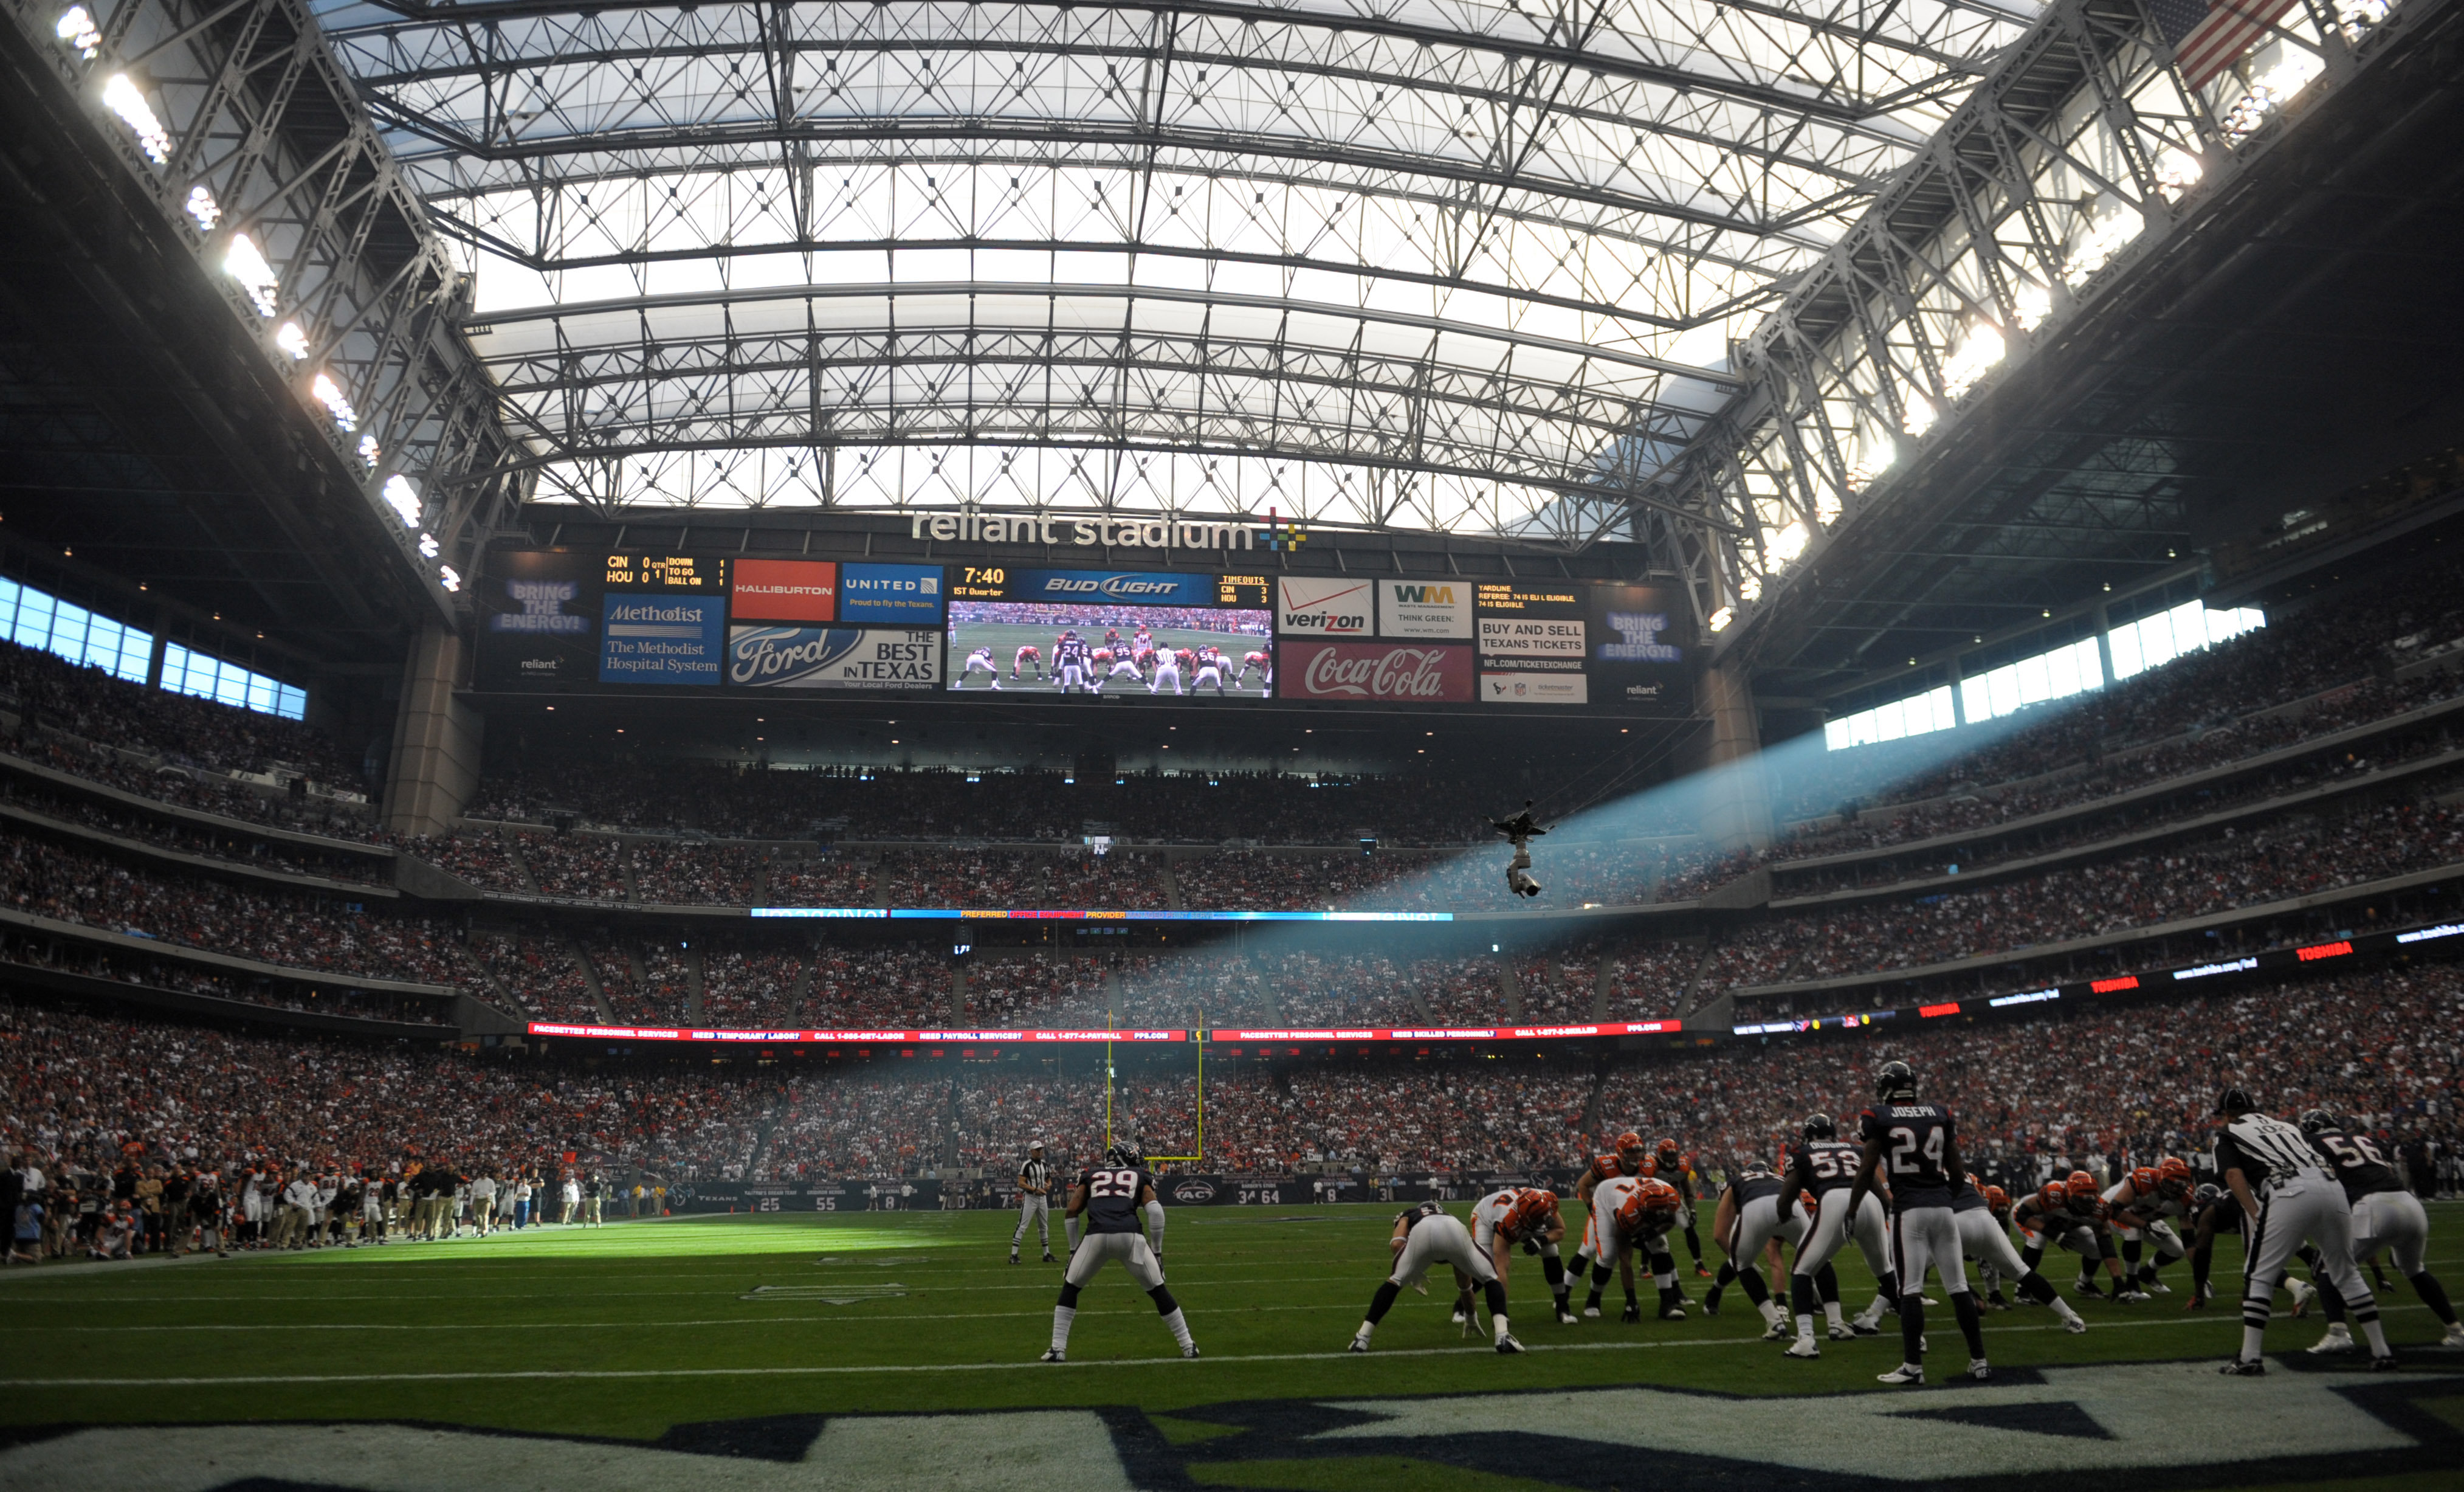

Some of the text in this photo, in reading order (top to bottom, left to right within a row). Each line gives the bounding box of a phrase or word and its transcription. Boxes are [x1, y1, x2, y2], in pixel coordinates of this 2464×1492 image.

[912, 505, 1253, 550] reliant stadium
[608, 556, 650, 568] CIN 0
[669, 558, 724, 567] DOWN 1
[607, 570, 649, 583] HOU 0
[655, 568, 660, 579] 1
[669, 567, 680, 576] TO
[719, 568, 724, 577] 1
[965, 567, 1004, 584] 7:40
[689, 577, 702, 585] ON
[845, 578, 917, 591] UNITED
[1045, 578, 1179, 595] BUD LIGHT
[1222, 575, 1265, 584] TIMEOUTS
[514, 584, 571, 601] BRING
[735, 584, 833, 596] HALLIBURTON
[954, 587, 1003, 596] 1ST Quarter
[1394, 584, 1455, 604] WM
[850, 598, 872, 607] Proud
[883, 599, 893, 609] fly
[1221, 594, 1267, 604] HOU 3
[524, 600, 559, 615] THE
[609, 604, 703, 623] Methodist
[500, 613, 580, 630] ENERGY!
[1285, 610, 1365, 632] verizon
[1614, 616, 1663, 631] BRING
[905, 631, 934, 643] THE
[1482, 623, 1582, 637] BUY AND SELL
[1623, 630, 1654, 644] THE
[608, 640, 704, 655] The Methodist
[1482, 638, 1582, 650] TEXANS TICKETS
[1605, 643, 1673, 658] ENERGY!
[731, 627, 831, 683] Ford
[876, 642, 934, 661] BEST
[1062, 645, 1079, 658] 24
[1116, 646, 1130, 657] 95
[1199, 651, 1215, 661] 56
[521, 658, 557, 669] reliant
[607, 657, 718, 674] Hospital System
[843, 661, 933, 680] IN TEXAS
[1484, 659, 1583, 670] NFL.COM/TICKETEXCHANGE
[1305, 646, 1447, 696] Coca-Cola
[904, 682, 933, 690] Dealers
[1626, 685, 1658, 694] reliant
[2296, 941, 2353, 961] TOSHIBA
[2091, 976, 2139, 993] TOSHIBA
[534, 1024, 678, 1039] PACESETTER PERSONNEL SERVICES
[1891, 1105, 1937, 1118] JOSEPH
[1888, 1125, 1945, 1174] 24
[2321, 1135, 2394, 1168] 56
[1808, 1150, 1862, 1178] 52
[1090, 1170, 1139, 1200] 29
[816, 1197, 836, 1211] 55
[885, 1196, 895, 1210] 8
[1261, 1190, 1280, 1204] 64
[760, 1197, 780, 1212] 25
